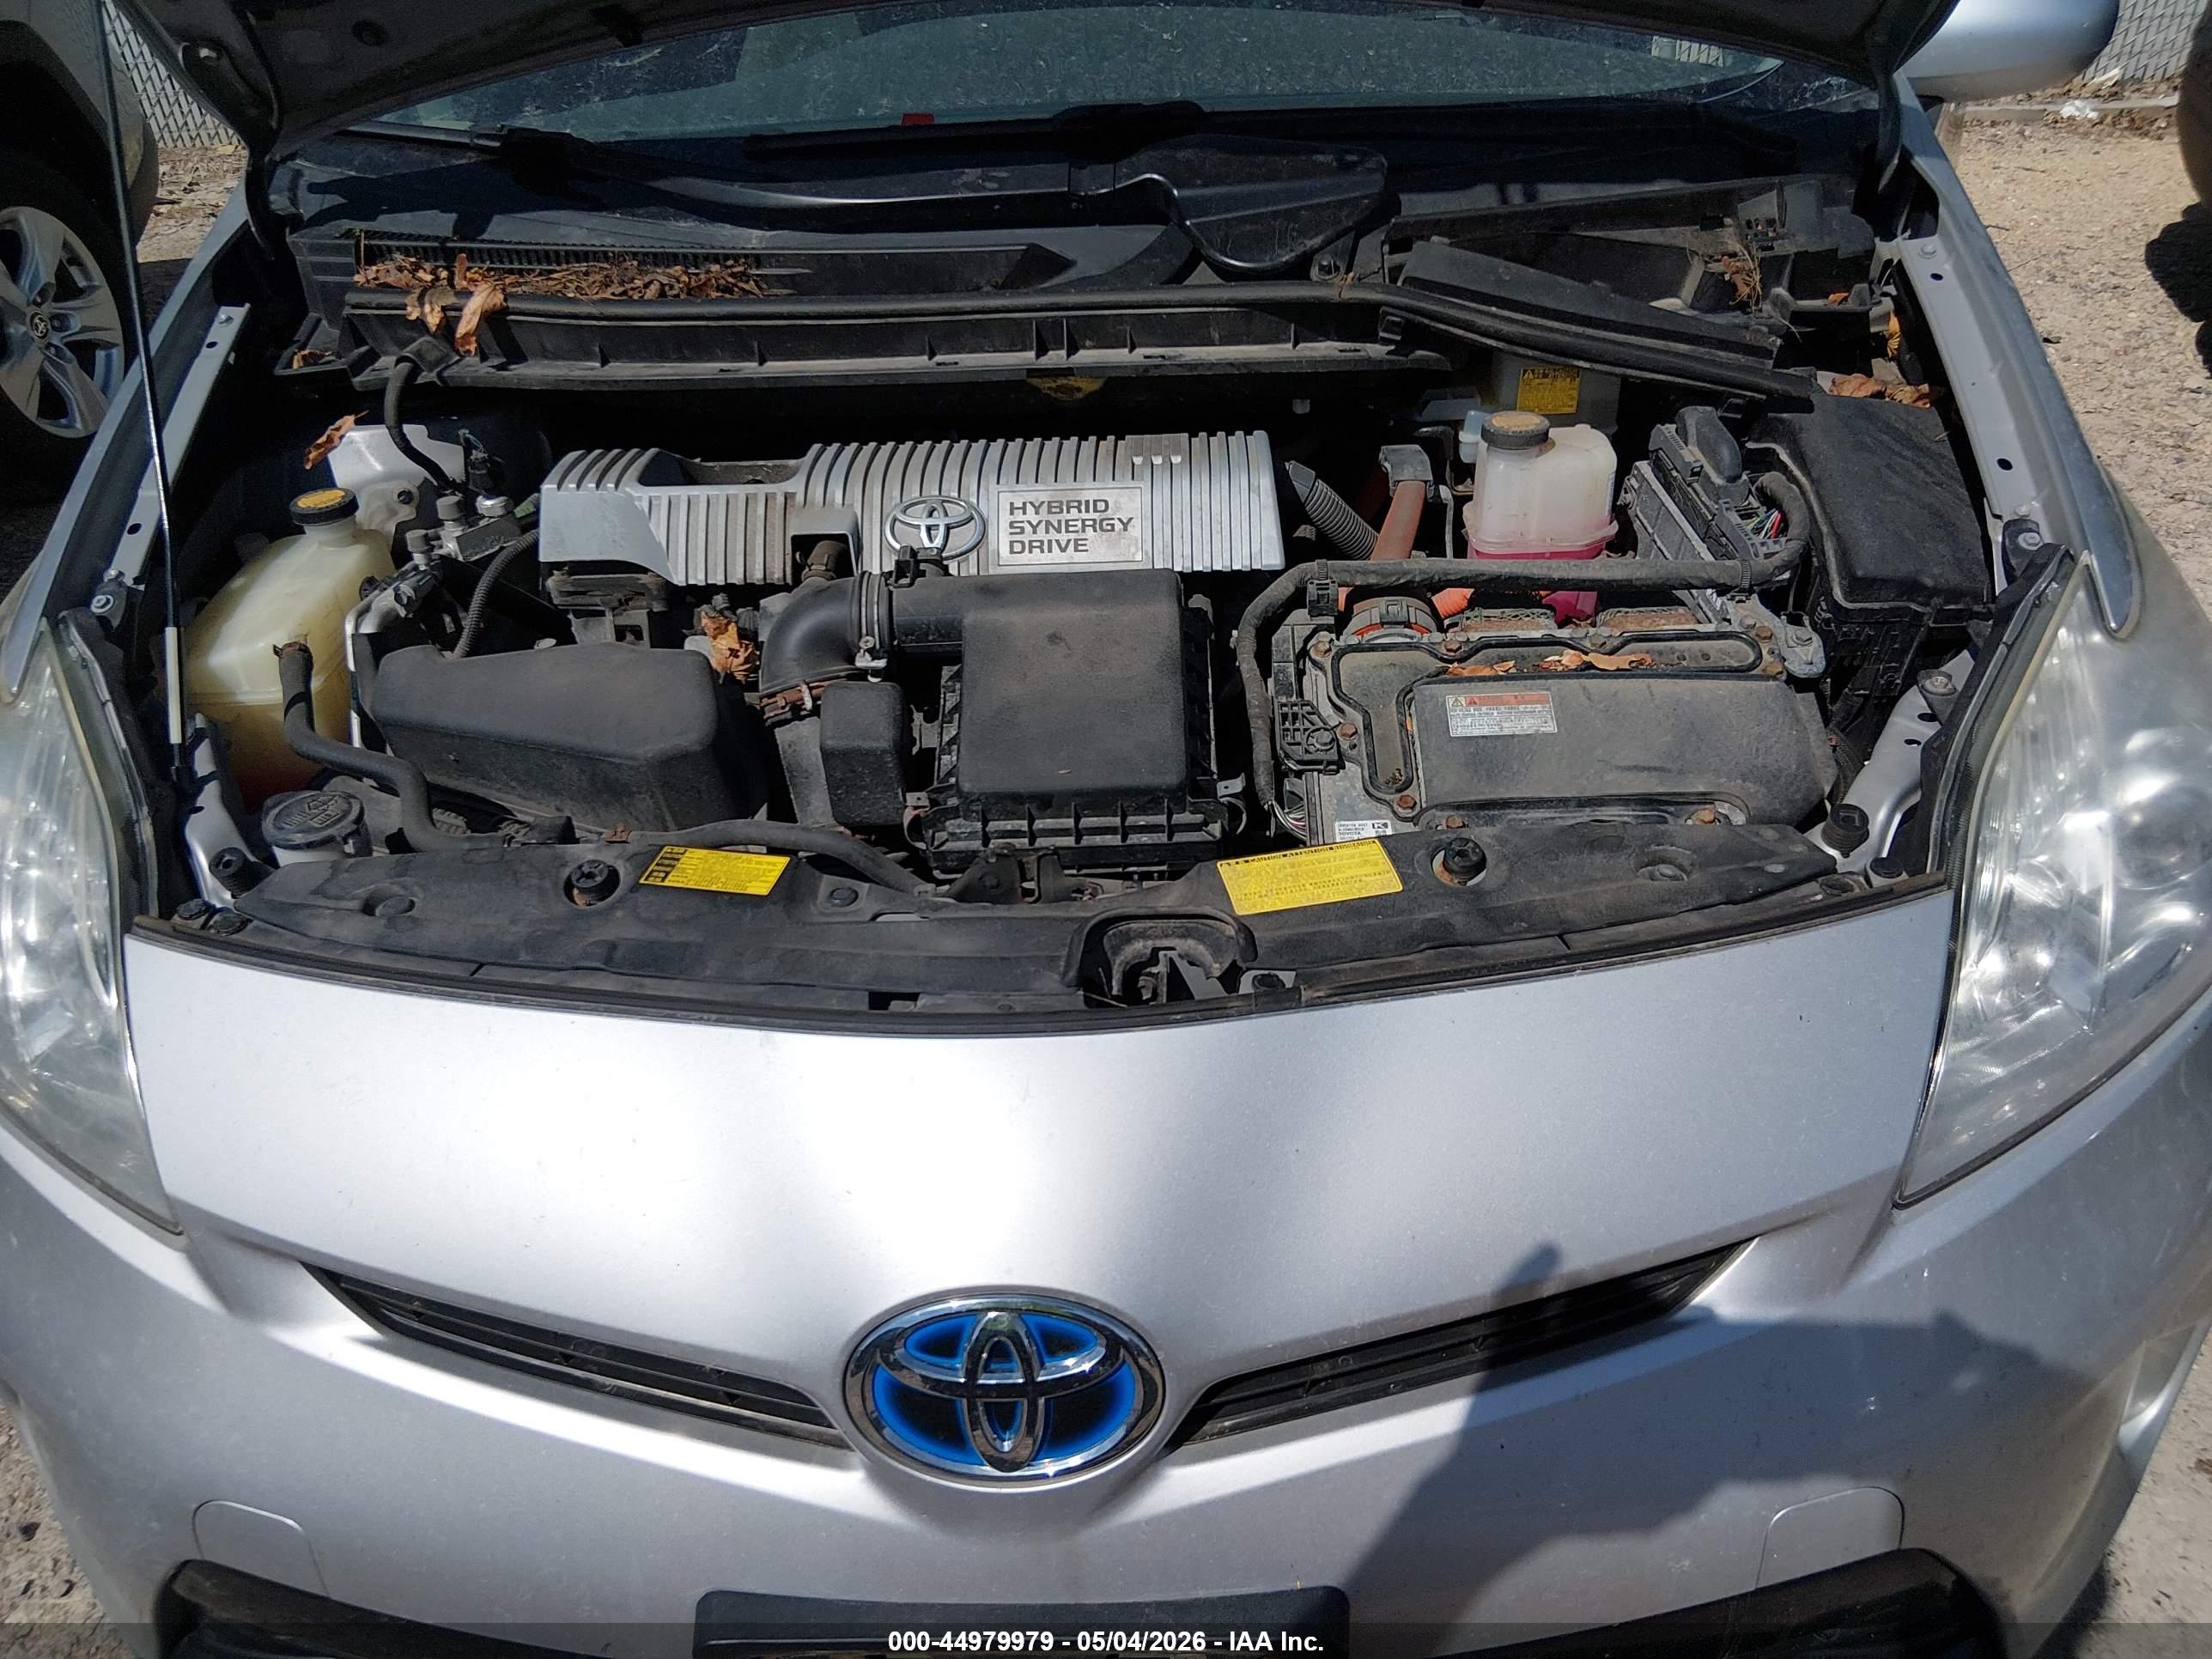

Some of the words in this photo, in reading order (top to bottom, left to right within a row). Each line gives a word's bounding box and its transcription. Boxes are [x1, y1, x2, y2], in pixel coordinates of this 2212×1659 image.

[1009, 499, 1109, 516] HYBRID
[1009, 517, 1134, 535] SYNERGY
[1009, 538, 1089, 555] DRIVE
